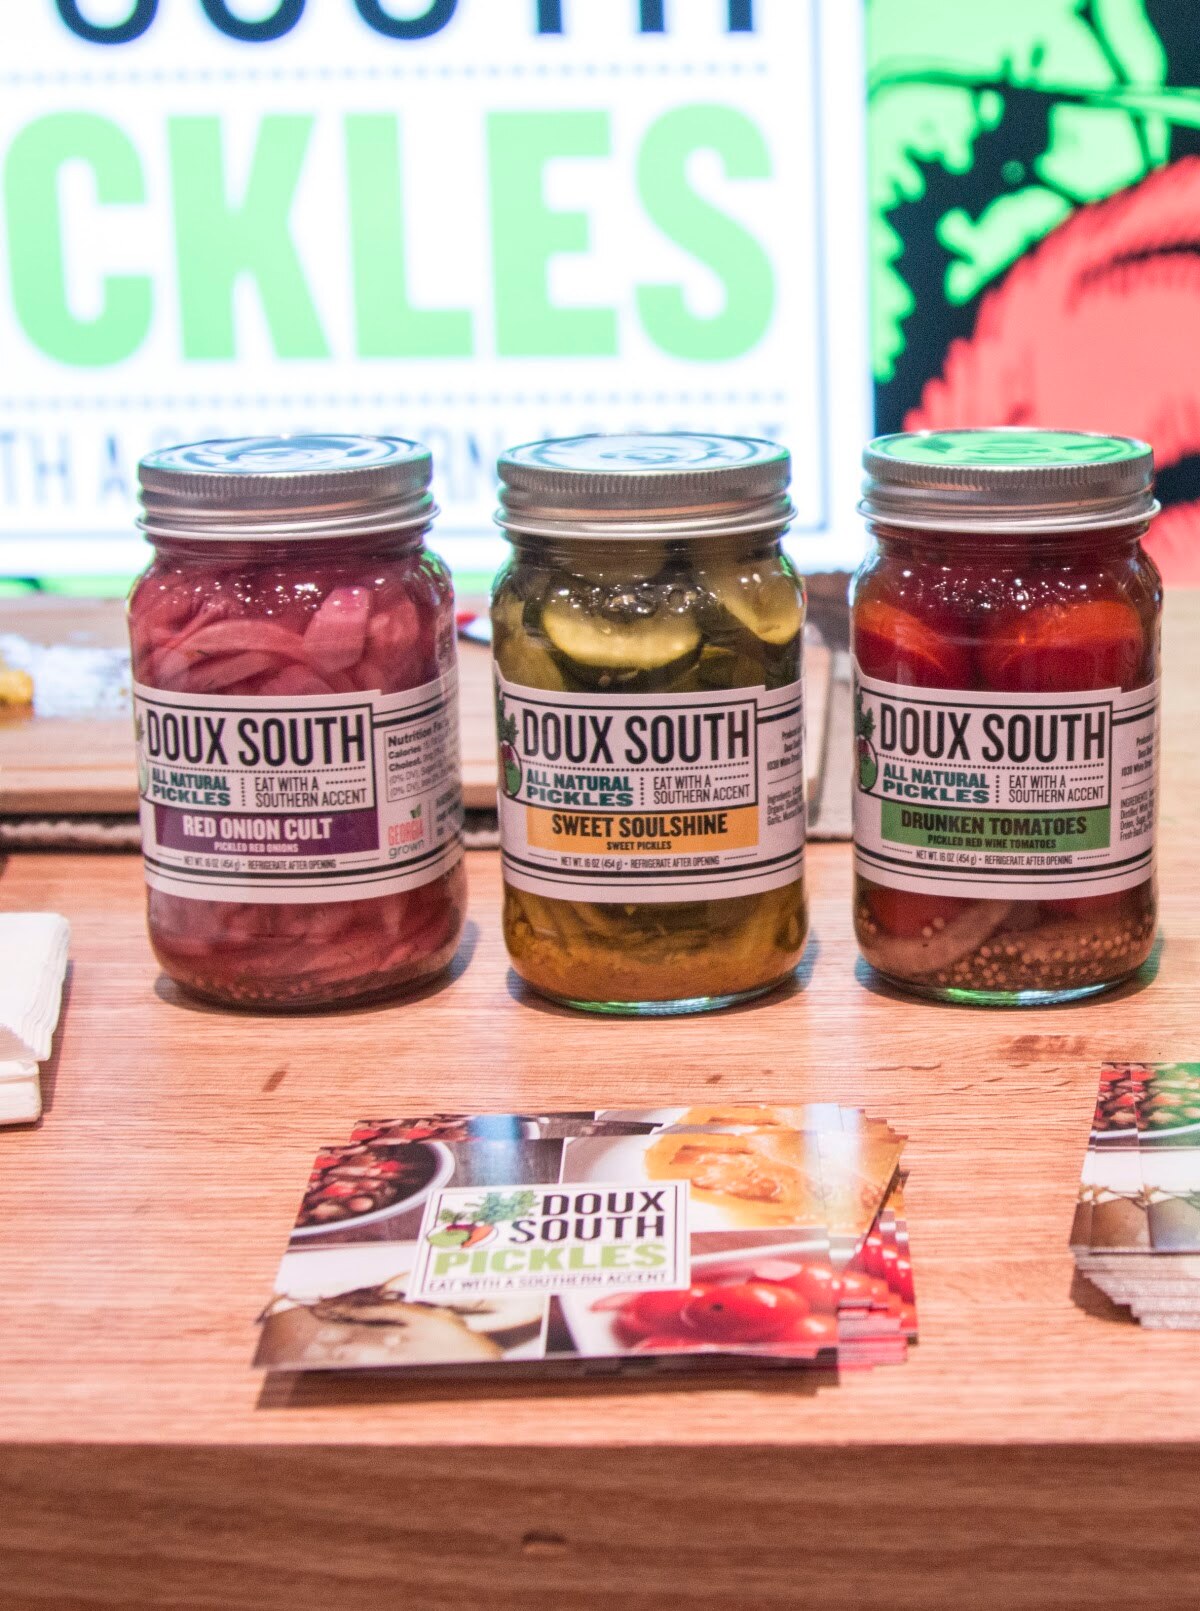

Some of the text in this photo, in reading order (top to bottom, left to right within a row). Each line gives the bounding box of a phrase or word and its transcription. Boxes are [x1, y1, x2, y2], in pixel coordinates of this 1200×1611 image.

[147, 709, 365, 766] DOUX SOUTH
[388, 727, 432, 747] Nutrition
[522, 708, 614, 764] DOUX
[625, 710, 749, 765] SOUTH
[881, 703, 972, 760] DOUX
[981, 711, 1105, 763] SOUTH
[153, 768, 230, 791] ALL NATURAL
[255, 776, 319, 791] EAT WITH A
[526, 769, 633, 792] ALL NATURAL
[653, 776, 711, 789] EAT WITH A
[884, 763, 989, 788] ALL NATURAL
[1009, 775, 1066, 789] EAT WITH A
[152, 784, 231, 806] PICKLES
[256, 788, 367, 807] SOUTHERN ACCENT
[526, 785, 633, 806] PICKLES
[654, 785, 749, 804] SOUTHERN ACCENT
[883, 780, 989, 803] PICKLES
[1009, 786, 1104, 802] SOUTHERN ACCENT
[183, 815, 332, 840] RED ONION CULT
[552, 813, 728, 837] SWEET SOULSHINE
[902, 810, 1087, 836] DRUNKEN TOMATOES
[214, 842, 298, 852] PICKLED RED ONIONS
[389, 839, 424, 859] grown
[607, 841, 671, 850] SWEET PICKLES
[928, 835, 1056, 848] PICKLED RED WINE TOMATOES
[541, 1191, 665, 1216] DOUX
[509, 1215, 664, 1244] SOUTH
[433, 1244, 667, 1275] PICKLES
[429, 1274, 666, 1291] EAT WITH A SOUTHERN ACCENT
